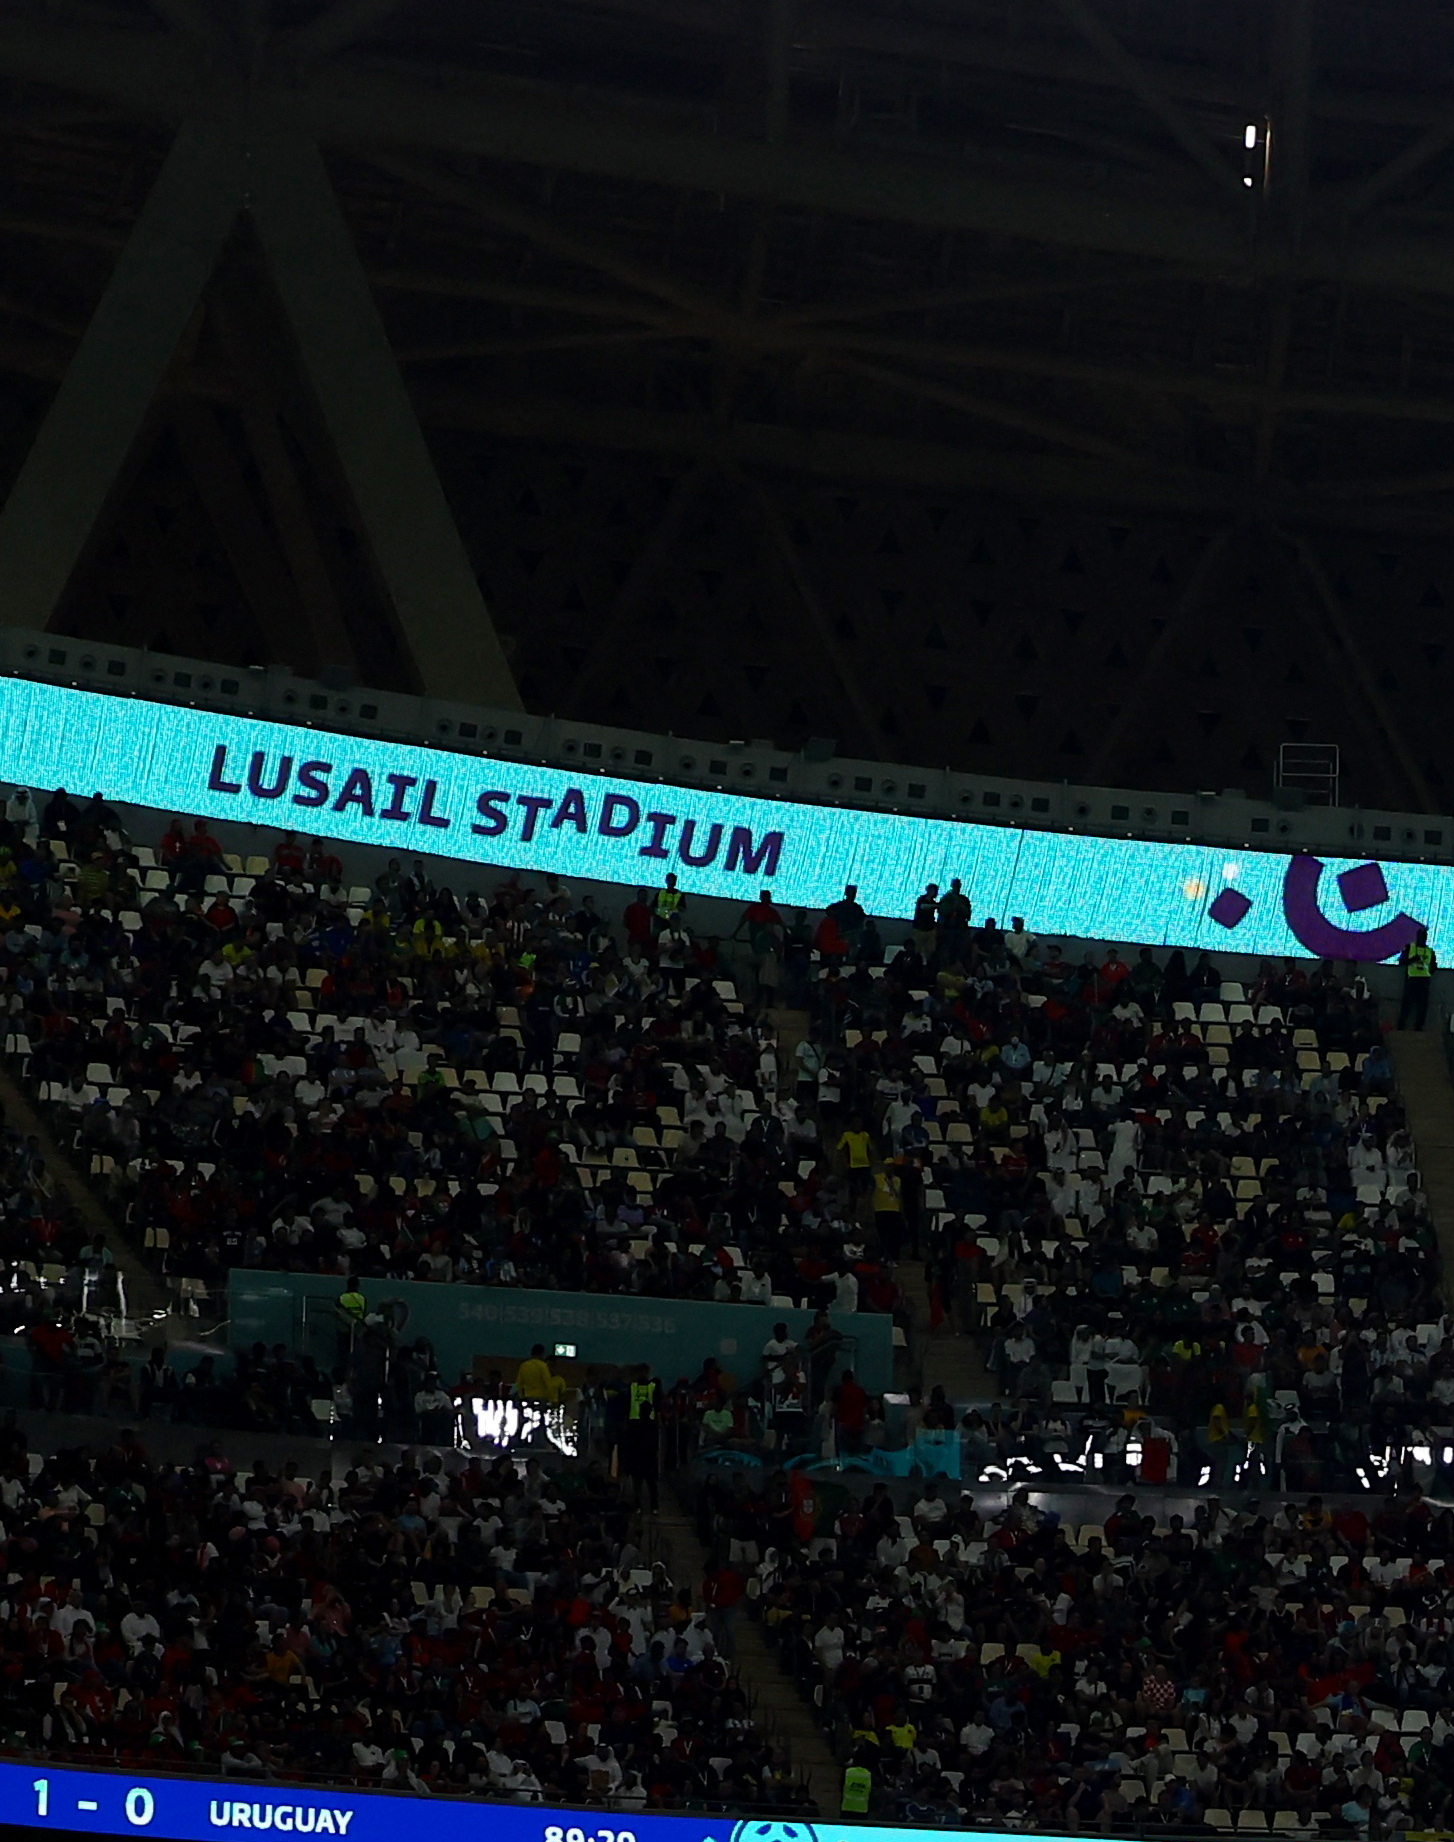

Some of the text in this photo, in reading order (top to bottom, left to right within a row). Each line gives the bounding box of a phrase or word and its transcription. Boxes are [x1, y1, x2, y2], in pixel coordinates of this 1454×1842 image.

[209, 746, 784, 877] LUSAIL STADIUM
[34, 1779, 49, 1817] 1
[125, 1787, 155, 1827] 0
[209, 1800, 354, 1836] URUGUAY
